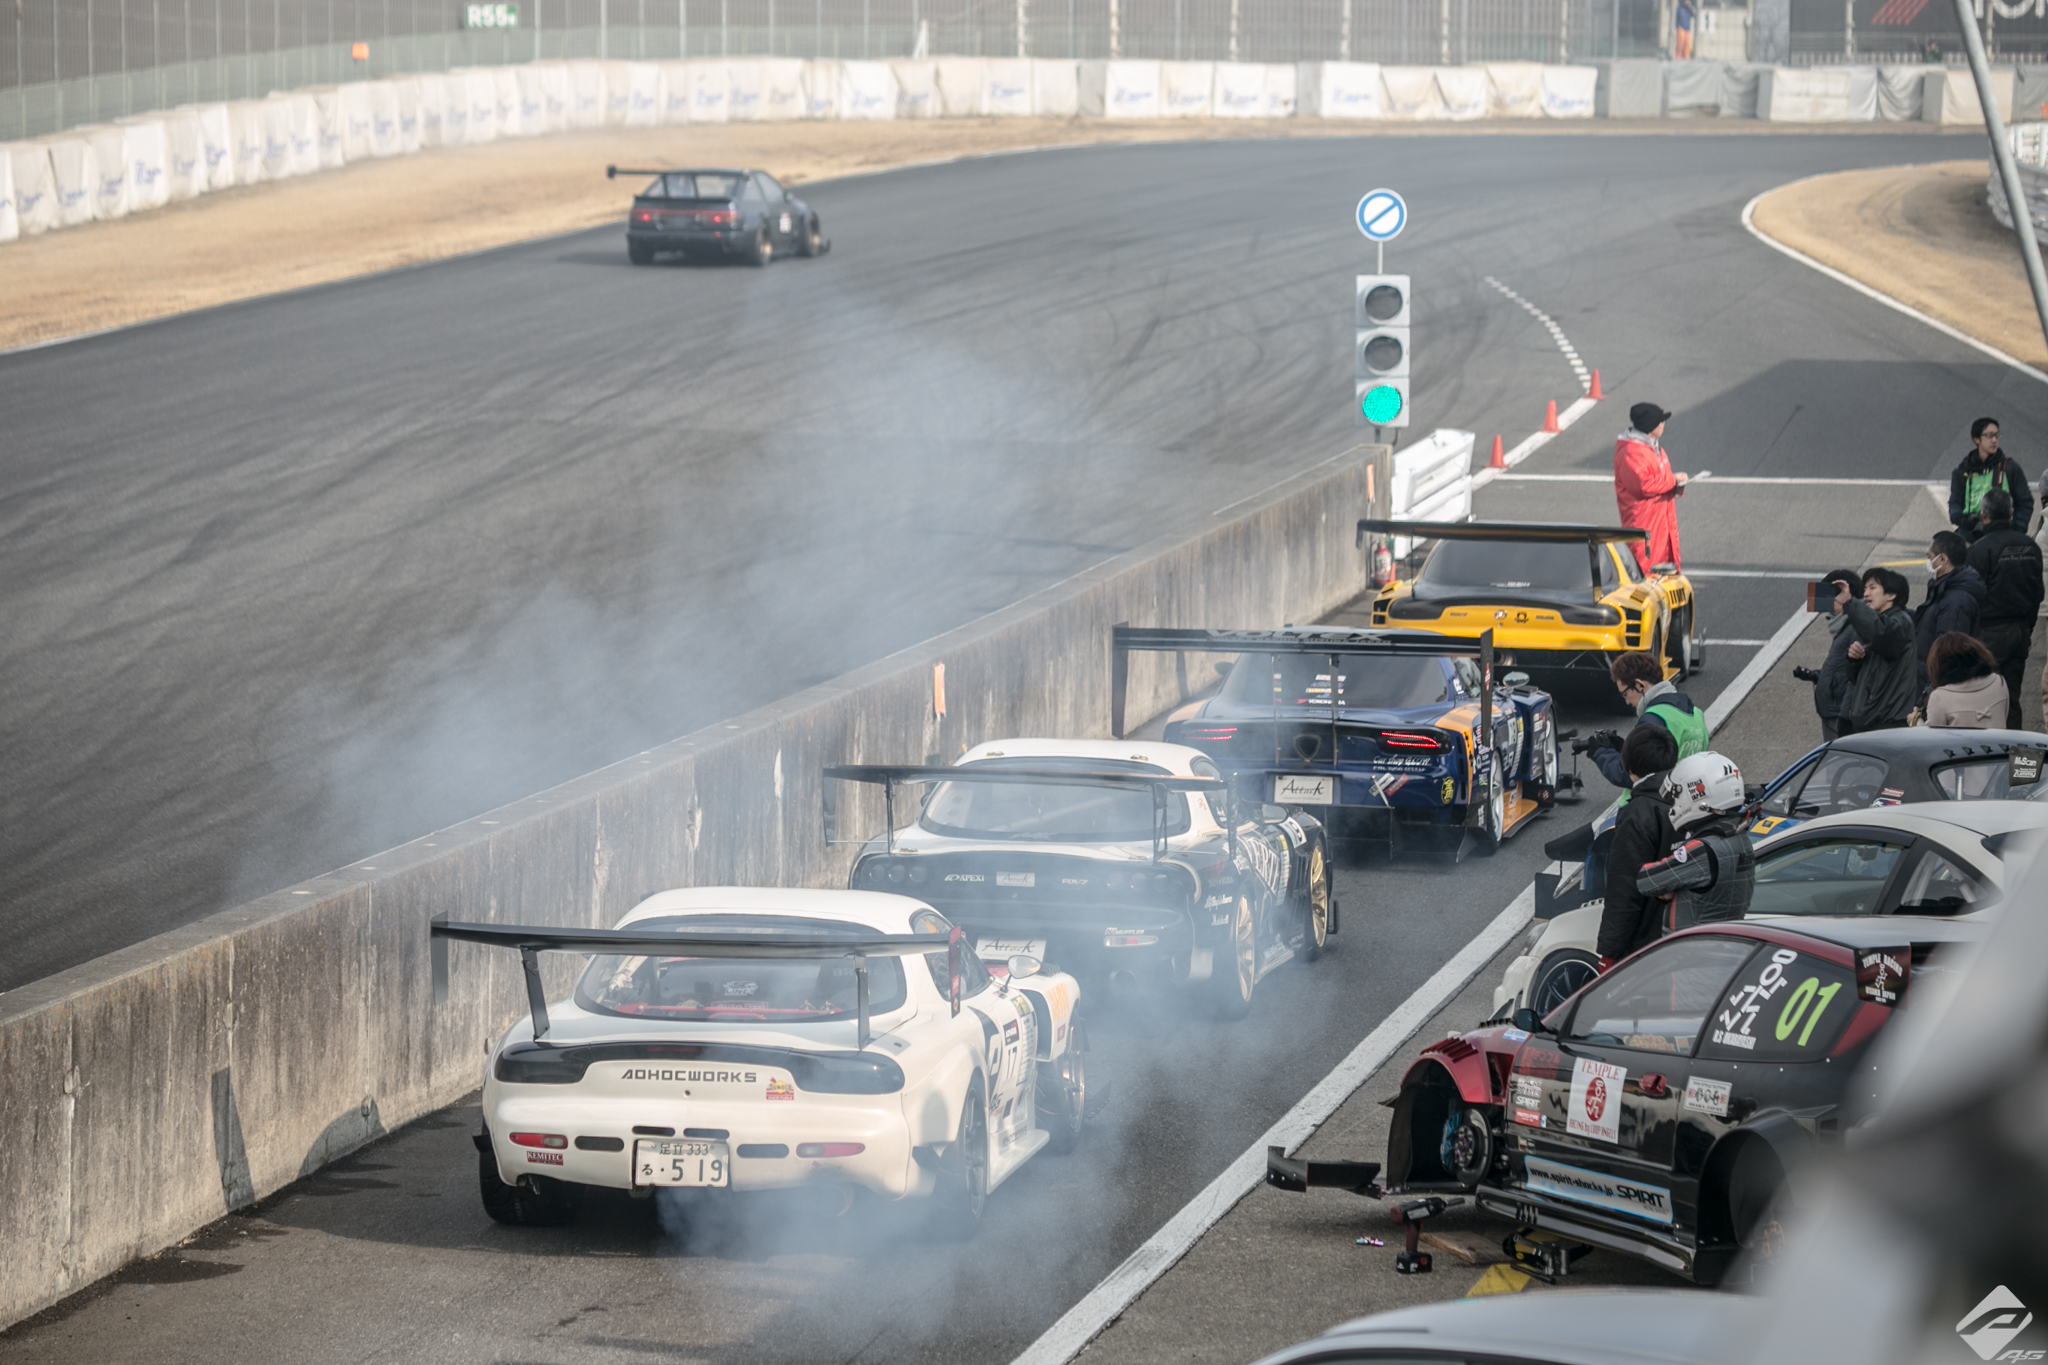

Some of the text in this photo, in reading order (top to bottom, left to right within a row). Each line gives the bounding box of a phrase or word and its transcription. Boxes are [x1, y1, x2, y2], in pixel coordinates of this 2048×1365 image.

[1281, 778, 1325, 796] Attack
[1061, 878, 1089, 886] RX-7
[981, 937, 1036, 954] Attack
[1862, 953, 1903, 977] TEMPLE RACING
[1775, 977, 1842, 1047] 01
[1581, 1060, 1621, 1081] TEMPLE
[768, 1083, 793, 1091] SUNOCO
[527, 1151, 563, 1161] KEMITEC
[660, 1143, 709, 1156] 足立 333
[642, 1163, 653, 1176] る
[1529, 1167, 1666, 1208] www.spirit-shocks.jp SPIRIT
